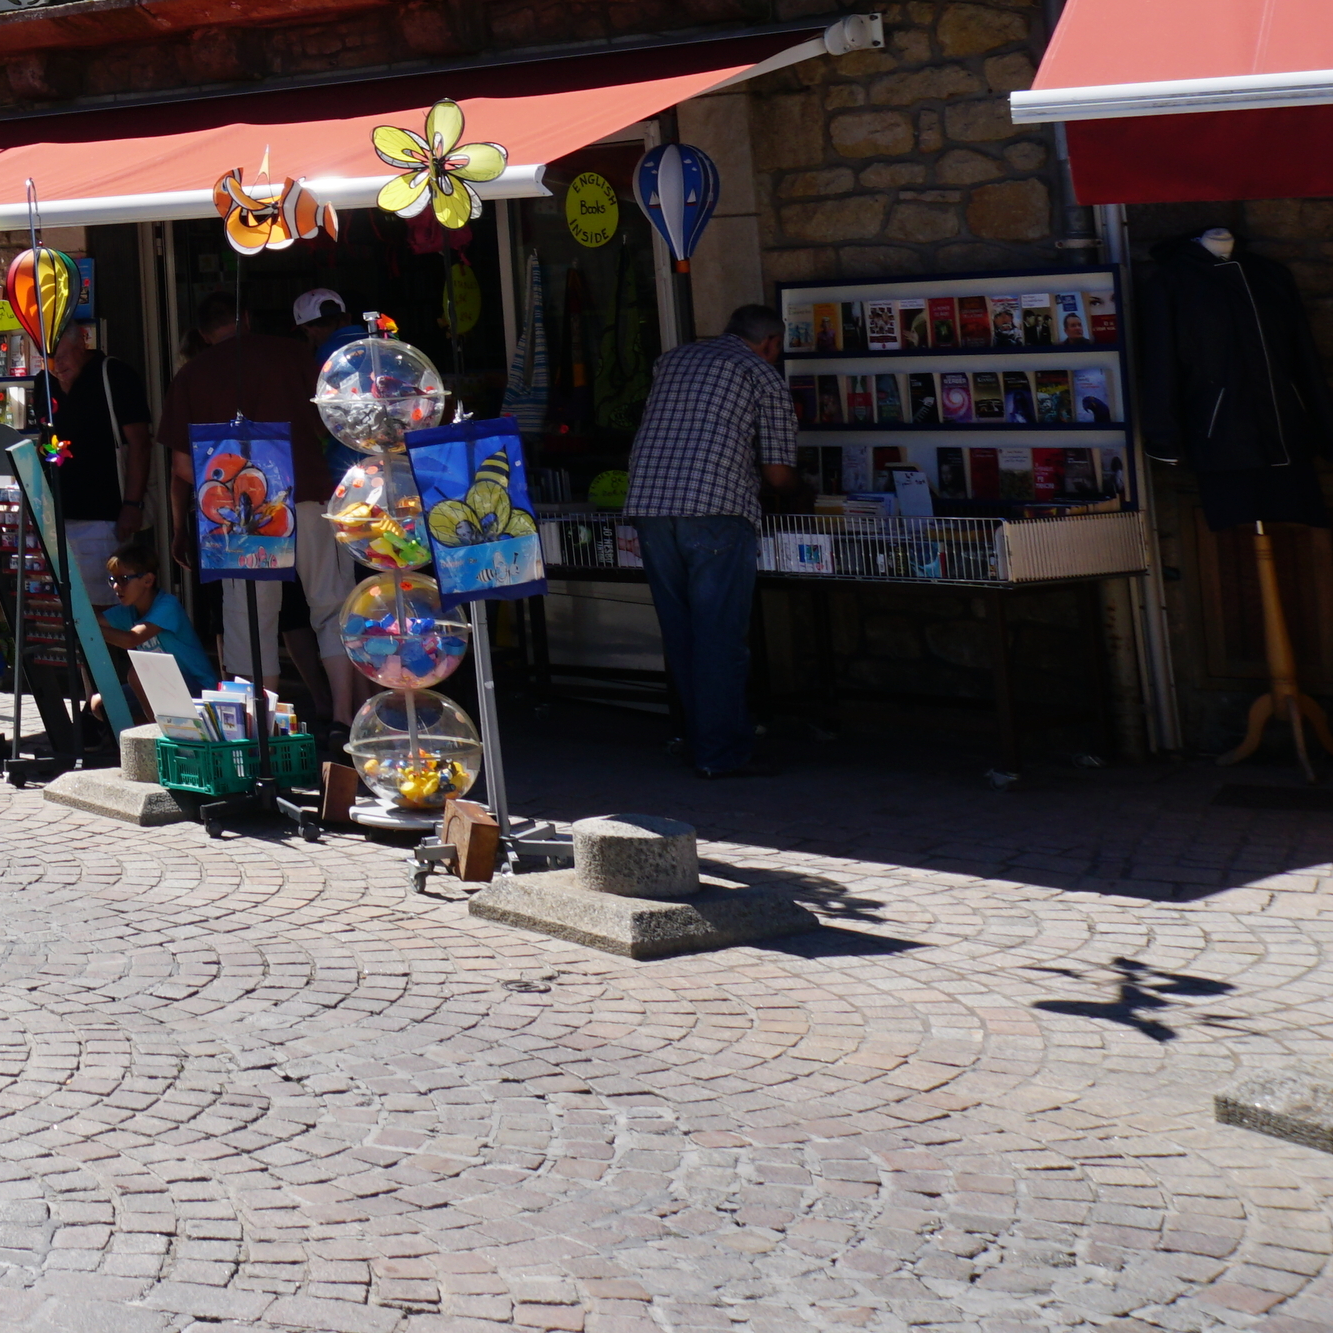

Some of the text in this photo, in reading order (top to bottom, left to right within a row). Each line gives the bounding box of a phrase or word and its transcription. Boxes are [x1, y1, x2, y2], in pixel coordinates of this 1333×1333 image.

[571, 174, 618, 207] ENGLISH
[579, 199, 607, 216] Books
[569, 218, 610, 244] INSIDE
